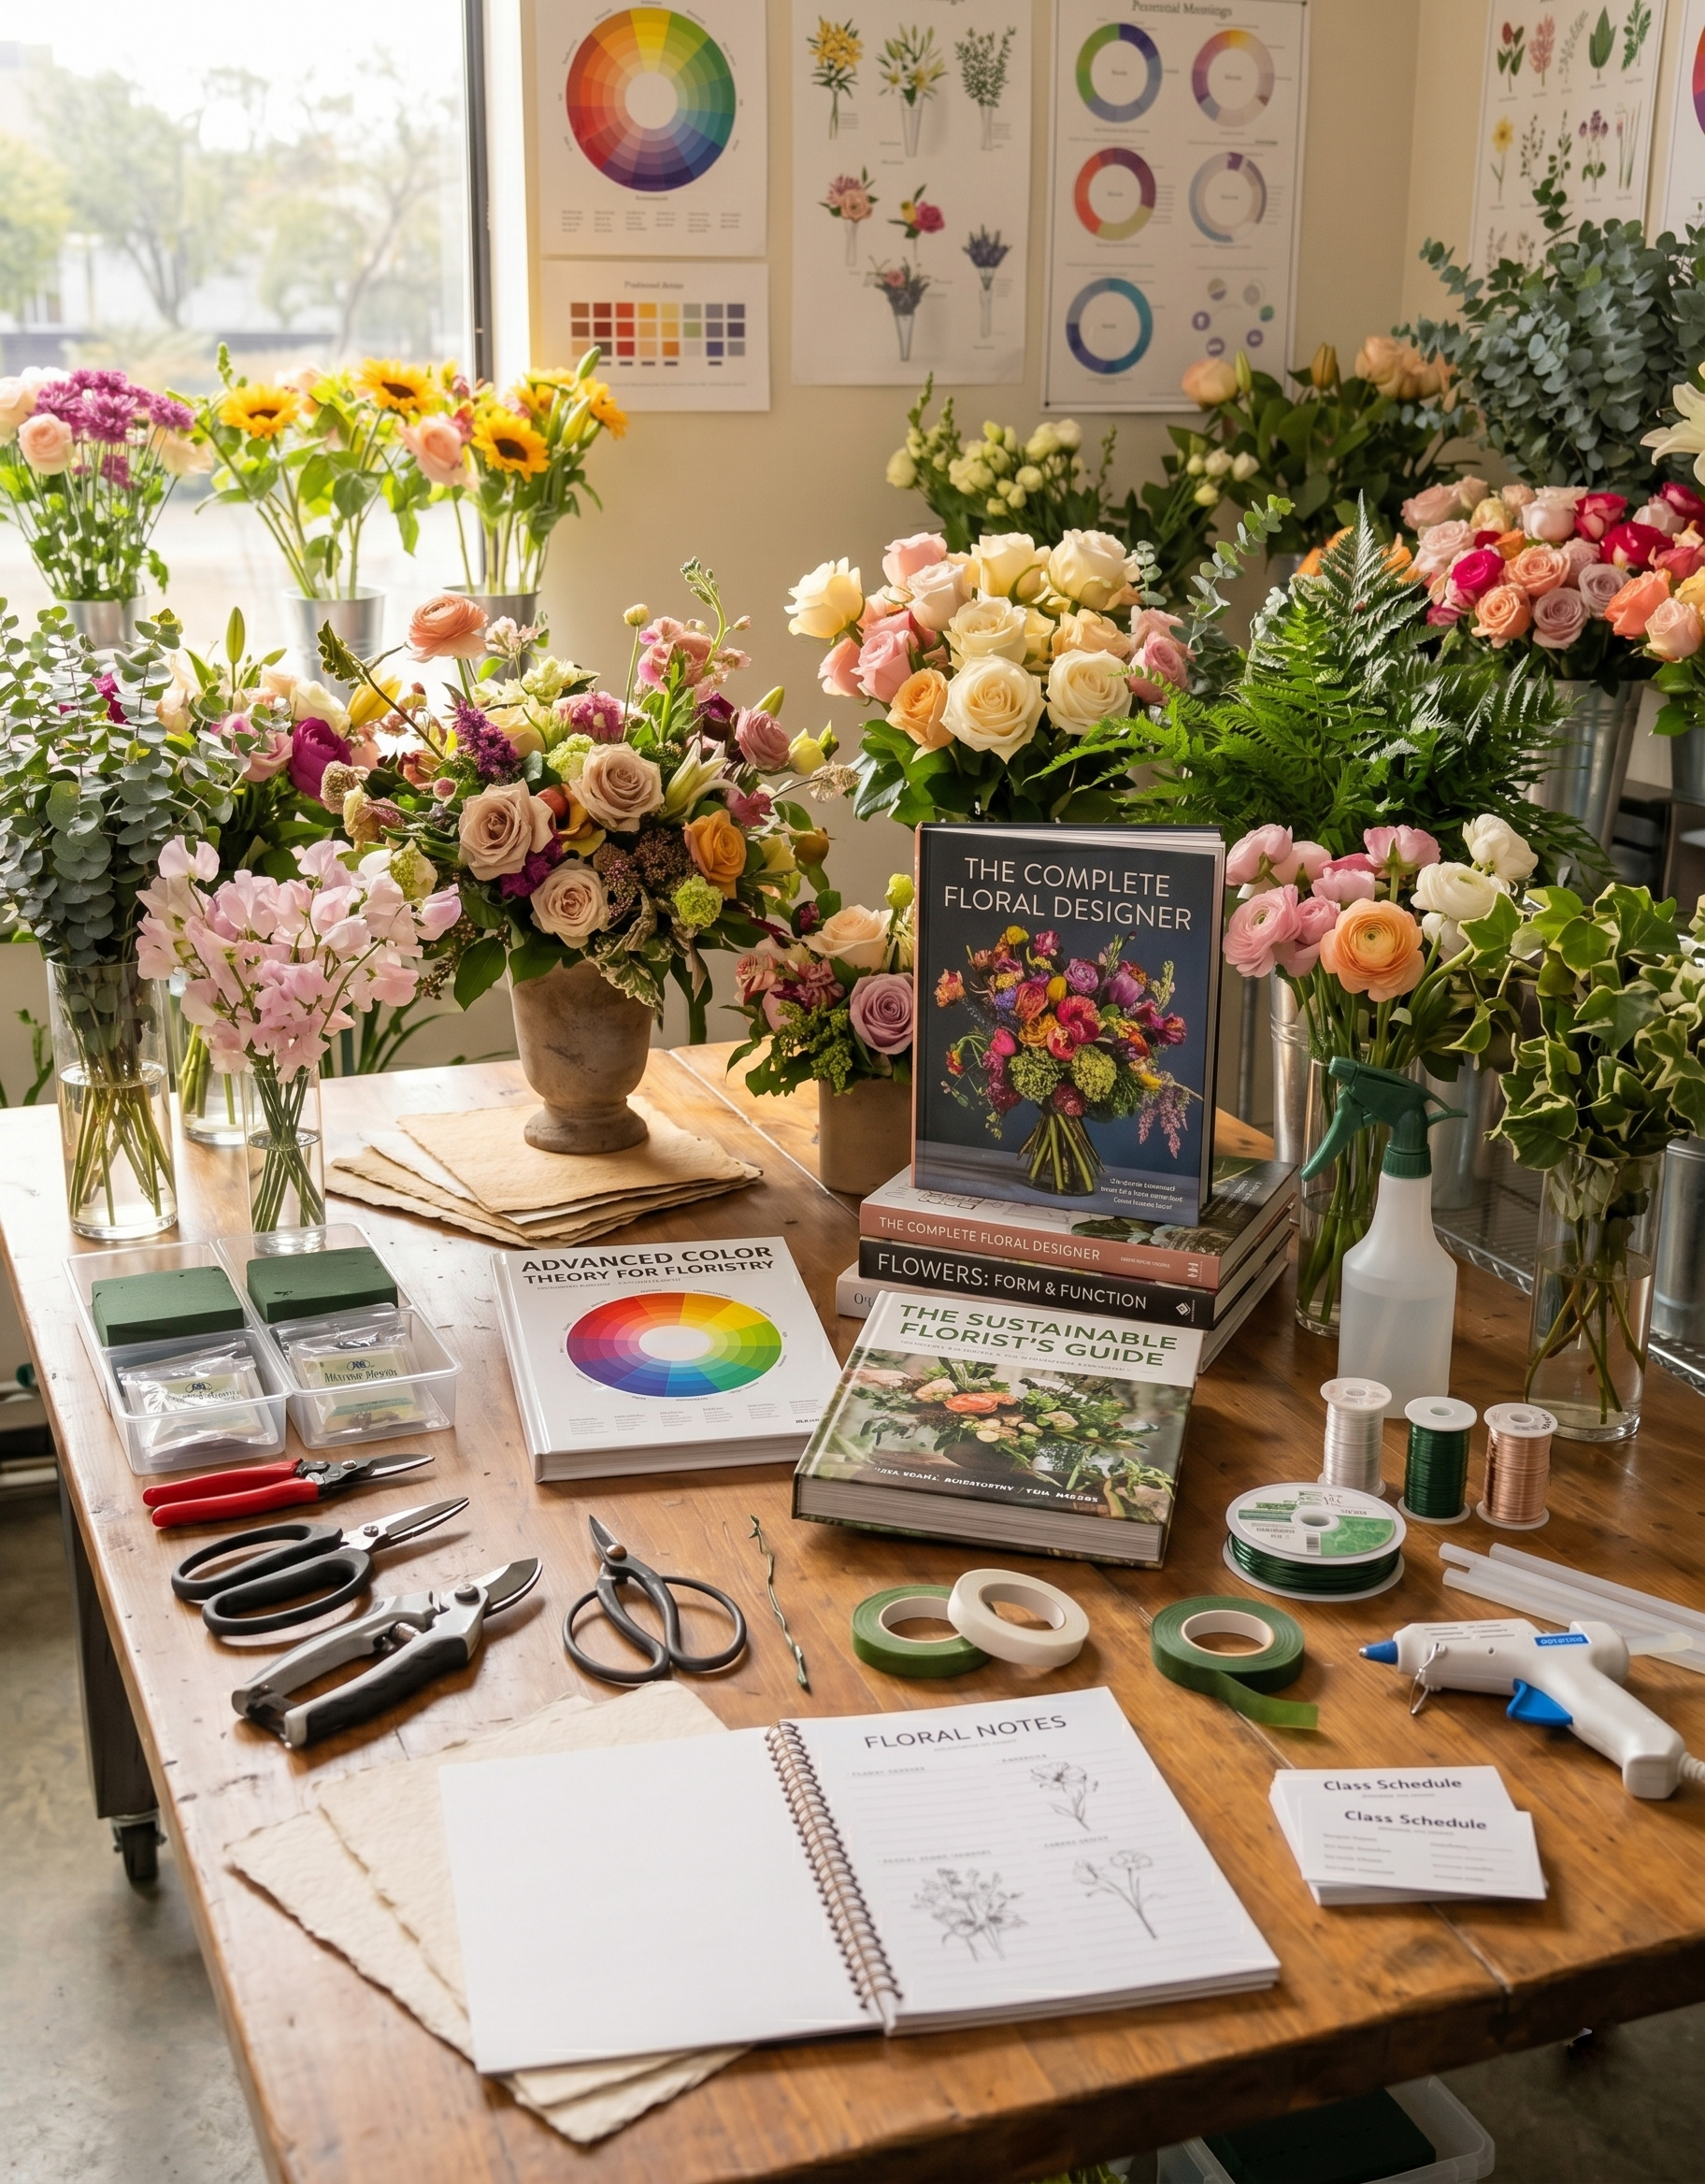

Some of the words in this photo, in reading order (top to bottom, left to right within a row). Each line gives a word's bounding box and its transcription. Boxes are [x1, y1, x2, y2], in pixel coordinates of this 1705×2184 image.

[965, 857, 1015, 883] THE
[1024, 863, 1170, 898] COMPLETE
[944, 885, 1045, 916] FLORAL
[1054, 896, 1192, 930] DESIGNER
[879, 1216, 904, 1231] THE
[907, 1221, 977, 1242] COMPLETE
[981, 1232, 1029, 1251] FLORAL
[1033, 1241, 1100, 1260] DESIGNER
[522, 1253, 673, 1272] ADVANCED
[681, 1246, 773, 1262] COLOR
[523, 1271, 609, 1285] THEORY
[616, 1268, 659, 1279] FOR
[665, 1260, 775, 1275] FLORISTRY
[878, 1253, 988, 1286] FLOWERS:
[995, 1273, 1040, 1293] FORM
[1045, 1281, 1056, 1296] &
[1060, 1284, 1147, 1310] FUNCTION
[900, 1304, 960, 1323] THE
[967, 1313, 1178, 1350] SUSTAINABLE
[900, 1322, 1055, 1353] FLORIST'S
[1065, 1343, 1165, 1366] GUIDE
[864, 1728, 971, 1748] FLORAL
[976, 1715, 1067, 1737] NOTES
[1324, 1780, 1371, 1791] Class
[1377, 1778, 1463, 1789] Schedule
[1344, 1810, 1393, 1823] Class
[1399, 1814, 1487, 1830] Schedule
